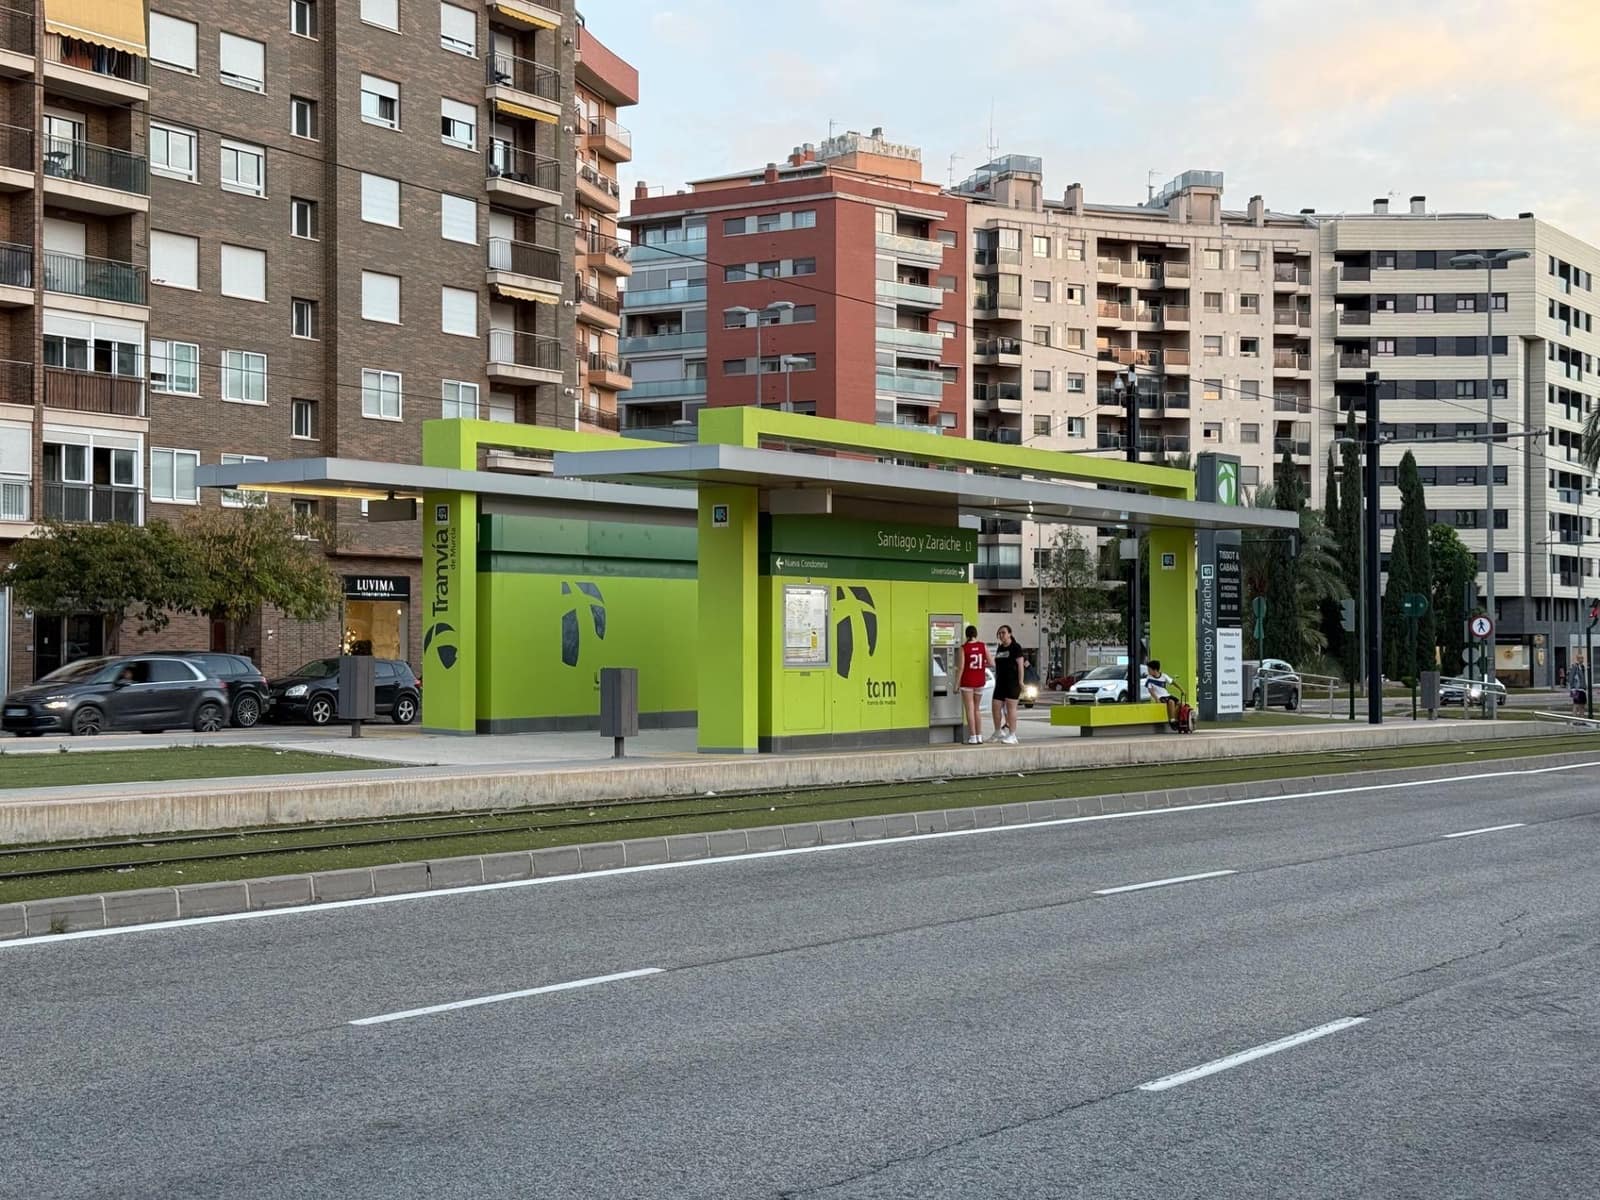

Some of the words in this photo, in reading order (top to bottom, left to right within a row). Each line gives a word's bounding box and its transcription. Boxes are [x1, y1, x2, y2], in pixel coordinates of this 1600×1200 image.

[877, 530, 917, 552] Santiago
[918, 537, 924, 552] y
[925, 534, 961, 552] Zaraiche
[965, 541, 972, 552] L1
[432, 528, 449, 617] Tranvía
[450, 560, 456, 570] de
[357, 579, 394, 591] LUVIMA
[1202, 579, 1212, 625] Zaraiche
[1203, 627, 1214, 635] y
[970, 653, 983, 669] 21
[1202, 636, 1215, 685] Santiago
[1204, 691, 1213, 700] L1
